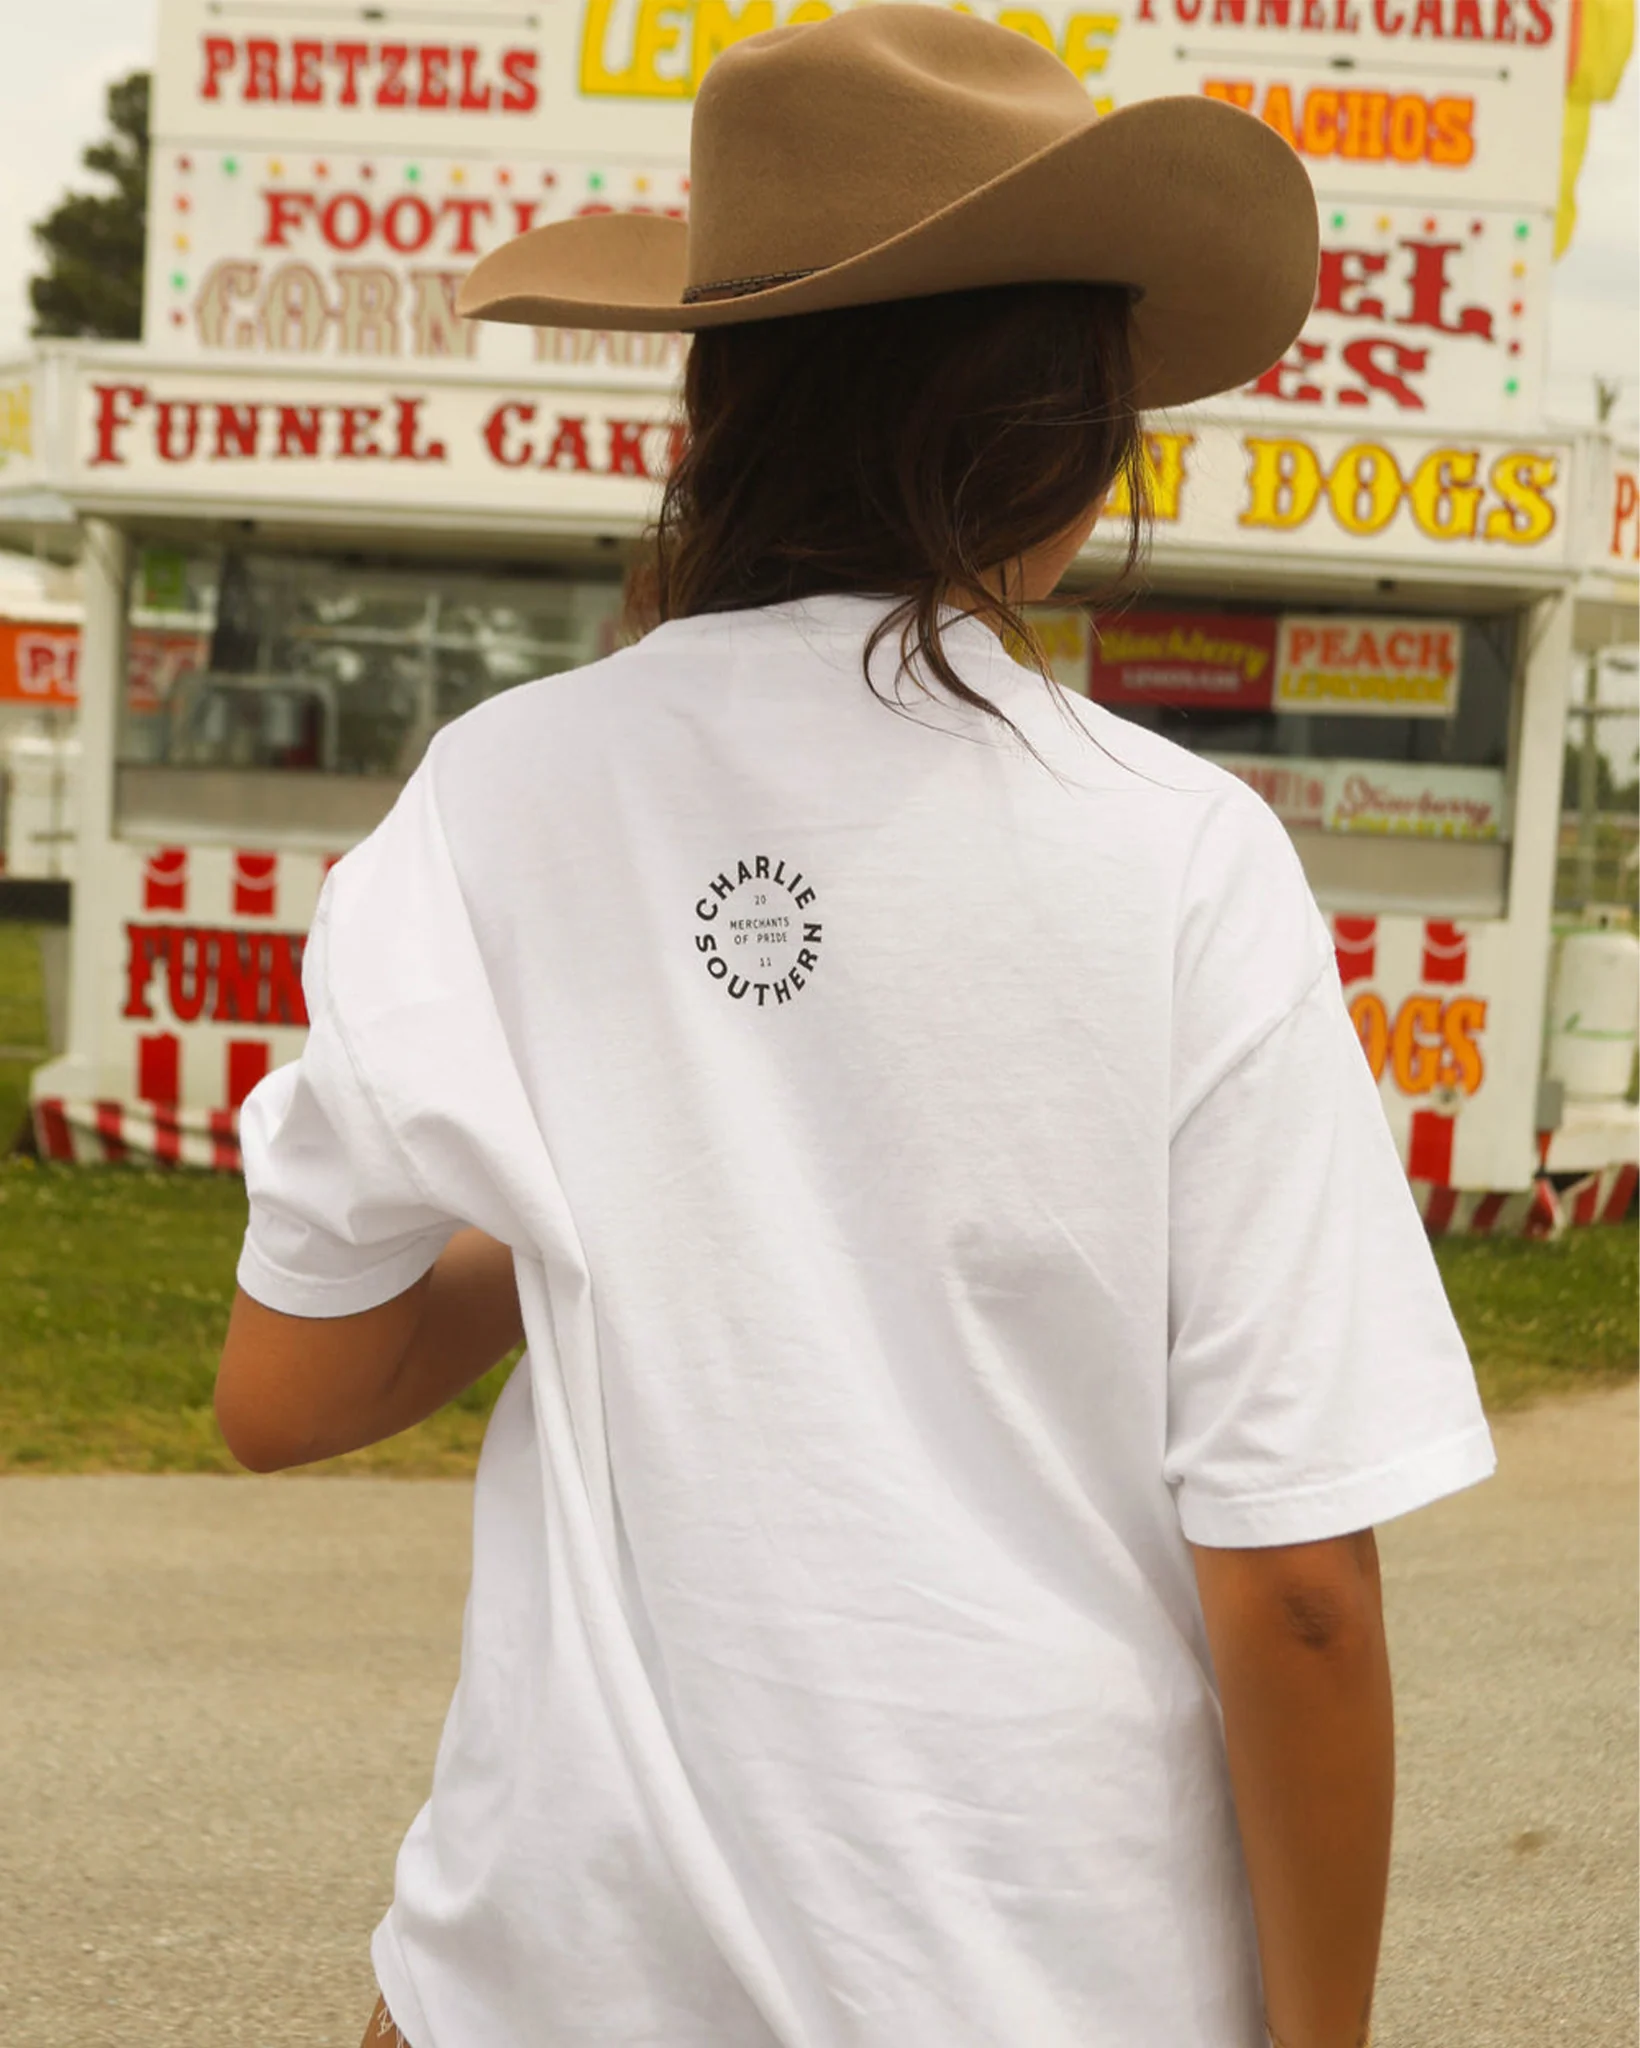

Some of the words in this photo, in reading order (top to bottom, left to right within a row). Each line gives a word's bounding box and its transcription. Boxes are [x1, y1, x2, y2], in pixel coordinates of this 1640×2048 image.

[201, 34, 540, 114] PRETZELS
[261, 190, 493, 255] FOOT
[195, 260, 480, 361] CORN
[88, 383, 446, 467] FUNNEL
[483, 400, 690, 480] CAK
[1238, 436, 1558, 546] DOGS
[1289, 625, 1456, 674] PEACH
[695, 855, 817, 921] CHARLIE
[730, 917, 790, 930] MERCHANTS
[754, 895, 767, 905] 20
[120, 922, 310, 1028] FUNN
[695, 922, 823, 1006] SOUTHERN
[734, 935, 749, 945] OF
[757, 932, 788, 944] PRIDE
[760, 957, 772, 967] 11
[1349, 991, 1487, 1098] OGS
